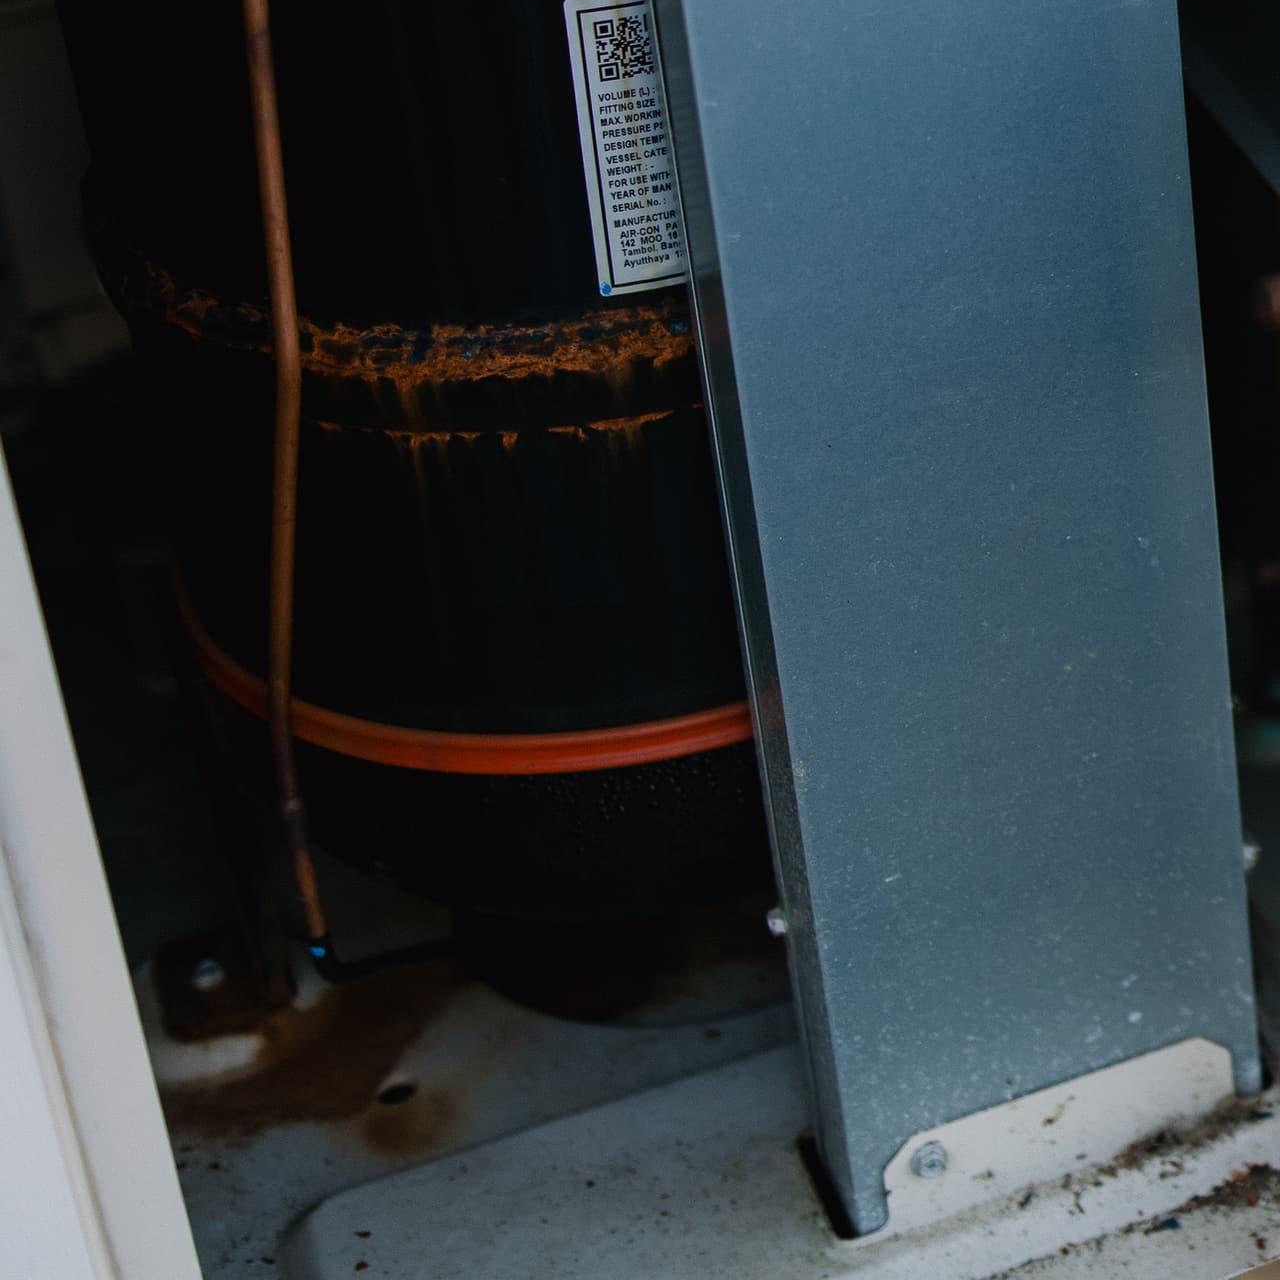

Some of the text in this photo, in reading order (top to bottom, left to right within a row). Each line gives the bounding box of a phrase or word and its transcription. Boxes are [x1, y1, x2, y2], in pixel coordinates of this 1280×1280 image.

[598, 89, 636, 102] VOLUME
[639, 87, 650, 97] (L)
[600, 98, 656, 115] FITTING SIZE
[601, 116, 623, 126] MAX.
[602, 124, 651, 139] PRESSURE
[604, 140, 638, 152] DESIGN
[605, 152, 642, 164] VESSEL
[607, 163, 642, 176] WEIGHT
[608, 178, 628, 188] FOR
[630, 175, 648, 185] USE
[611, 189, 636, 200] YEAR
[637, 187, 649, 196] OF
[612, 200, 645, 213] SERIAL
[647, 199, 662, 208] No.
[620, 224, 660, 239] AIR-CON
[620, 239, 636, 248] 142
[640, 234, 663, 245] MOO
[622, 244, 658, 256] Tambol.
[623, 253, 670, 268] Ayutthaya
